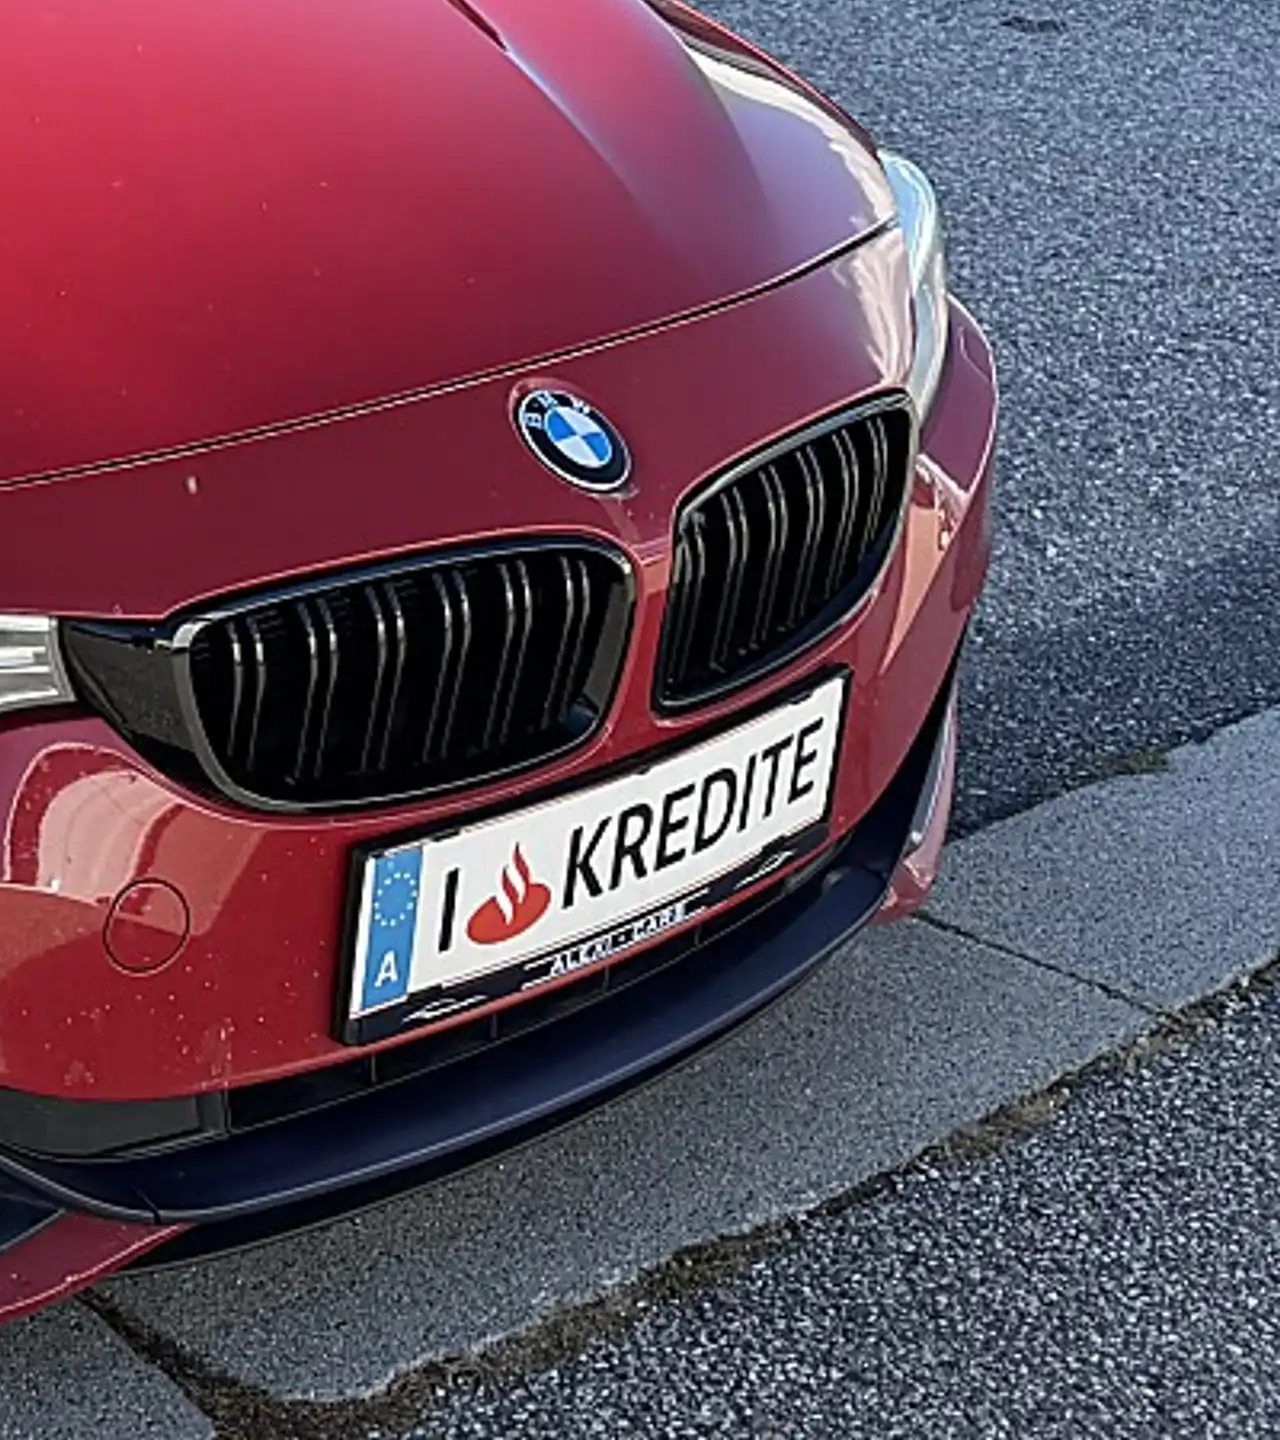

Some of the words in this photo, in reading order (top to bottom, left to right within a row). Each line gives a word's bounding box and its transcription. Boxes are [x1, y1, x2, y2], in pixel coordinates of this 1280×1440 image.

[438, 867, 459, 953] I
[561, 717, 824, 910] KREDITE
[373, 950, 398, 988] A
